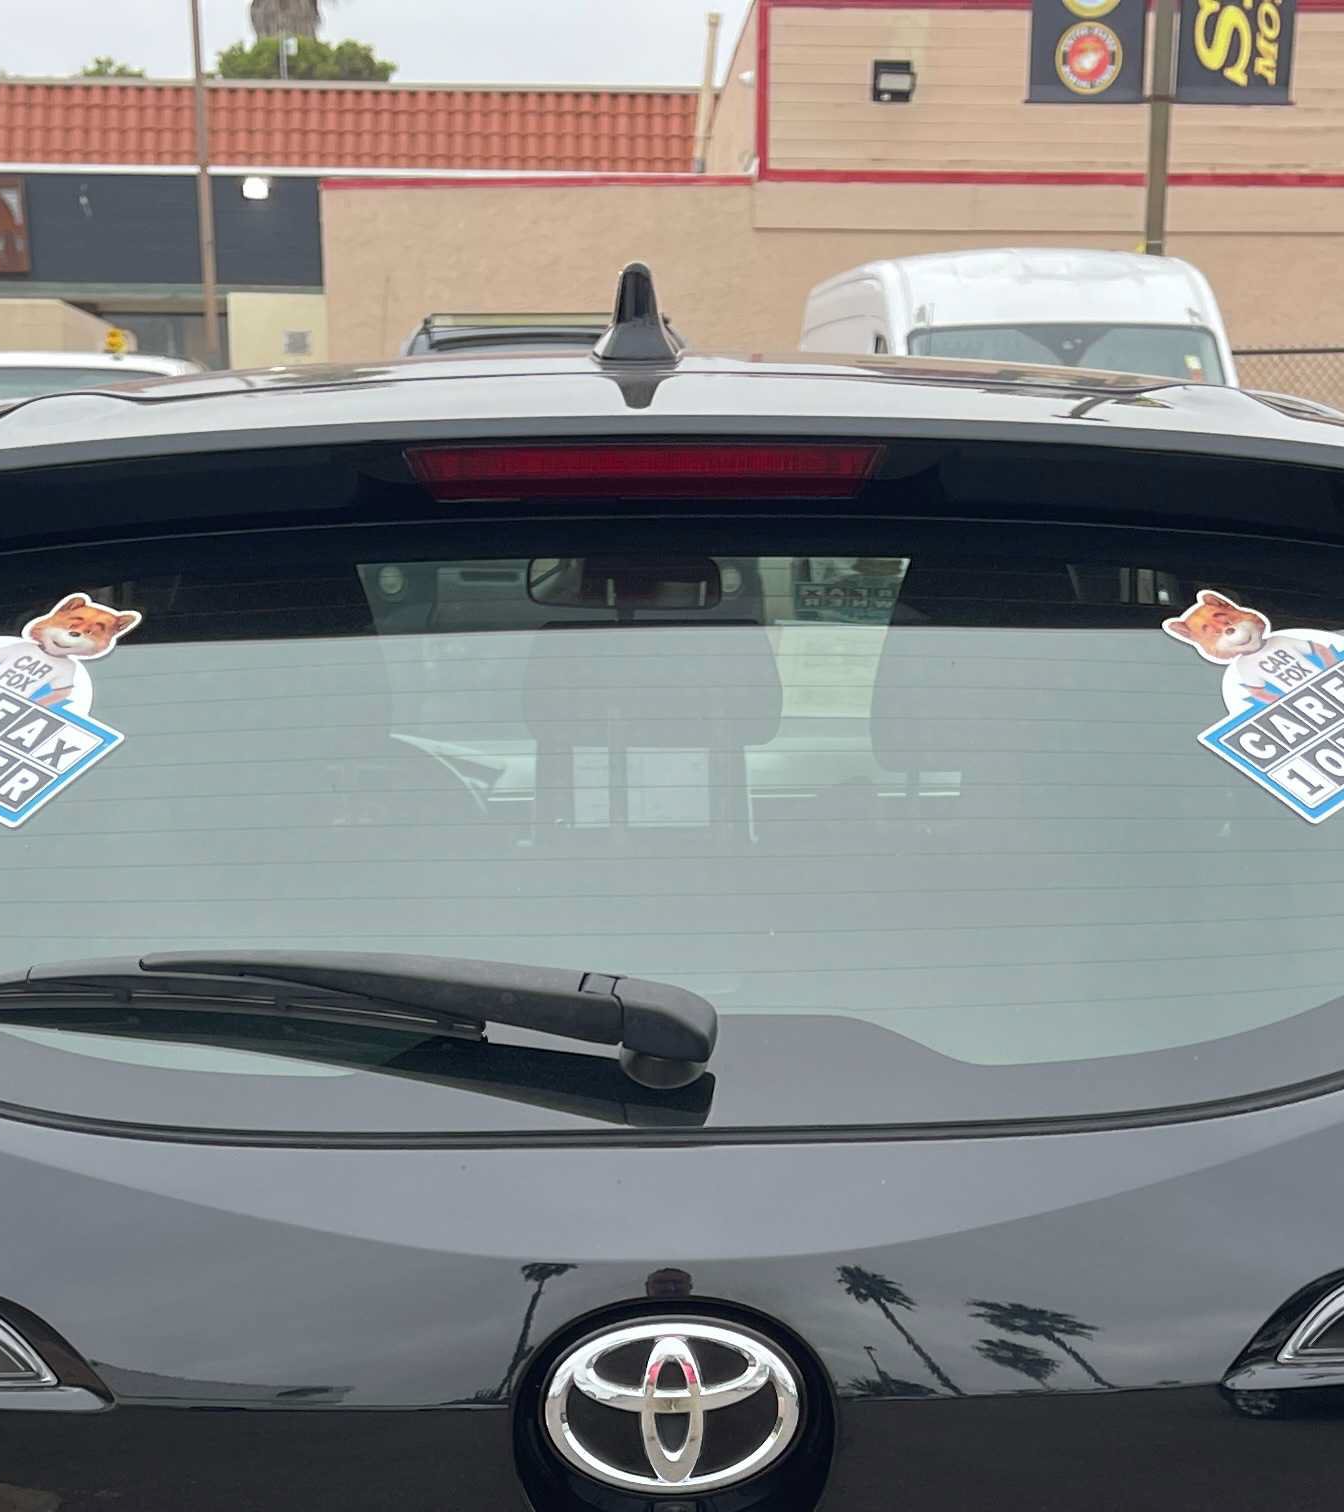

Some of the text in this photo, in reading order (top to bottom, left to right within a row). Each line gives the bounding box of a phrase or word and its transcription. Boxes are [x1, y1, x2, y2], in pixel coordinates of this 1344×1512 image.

[13, 655, 52, 676] CAR
[1259, 650, 1296, 675] CAR
[1276, 664, 1313, 687] FOX
